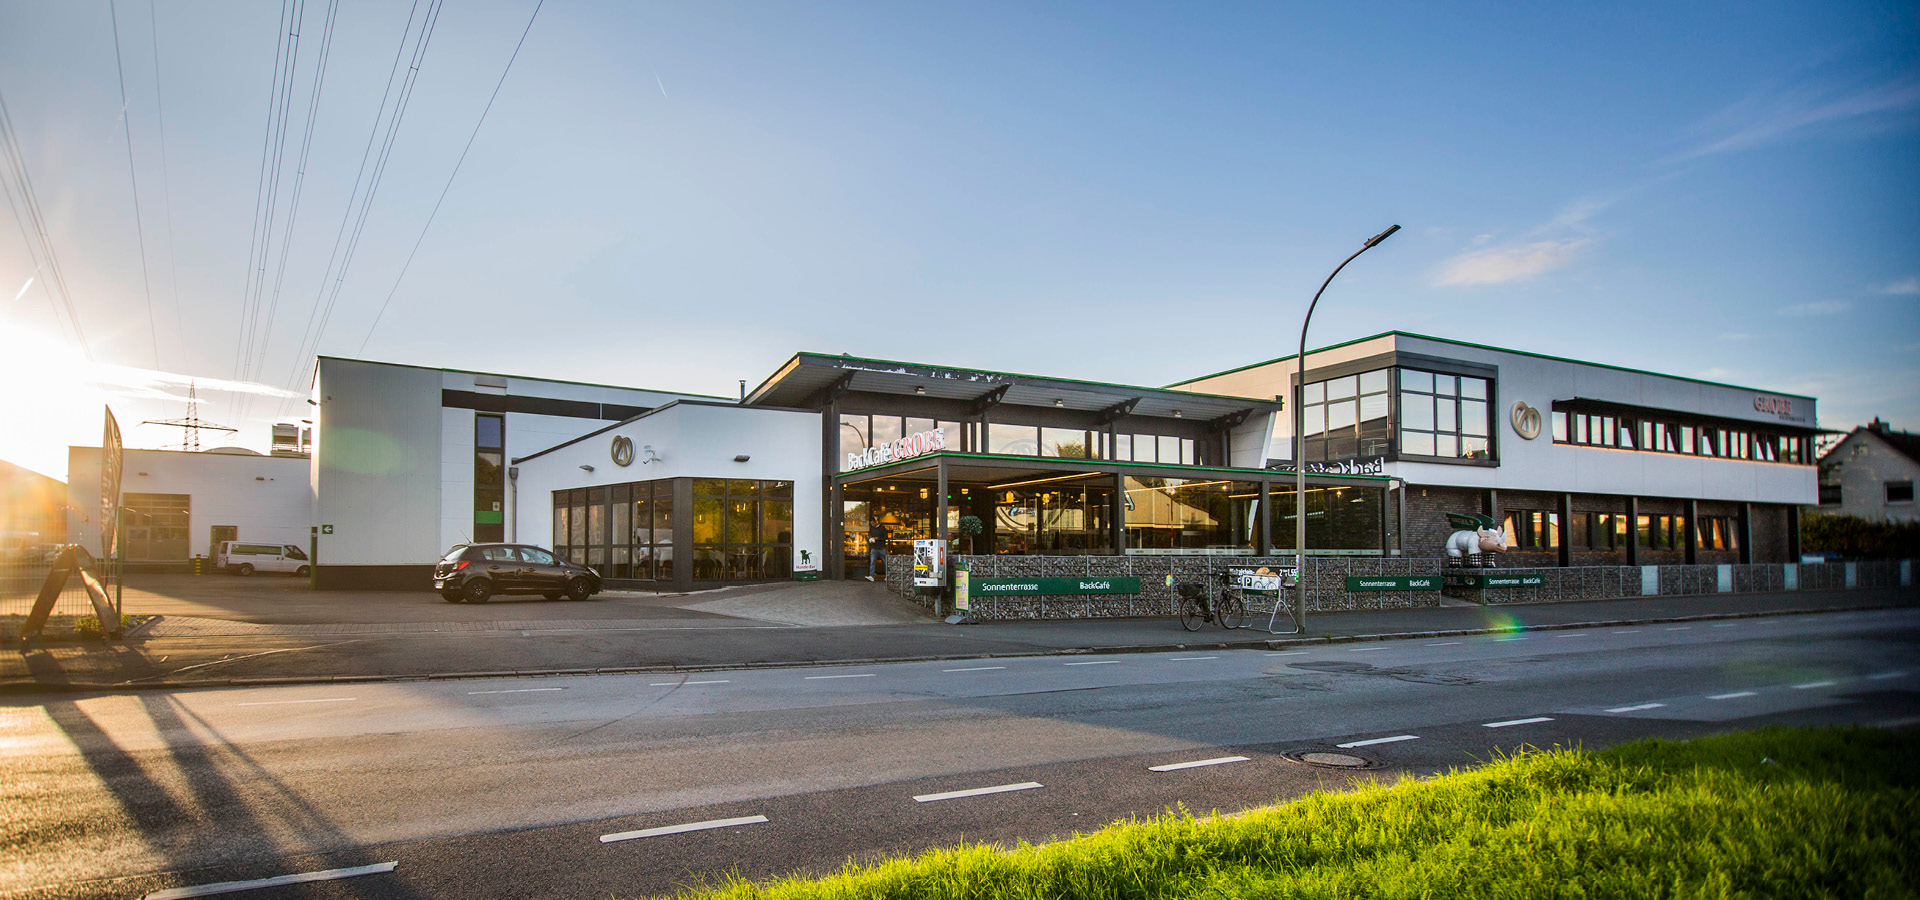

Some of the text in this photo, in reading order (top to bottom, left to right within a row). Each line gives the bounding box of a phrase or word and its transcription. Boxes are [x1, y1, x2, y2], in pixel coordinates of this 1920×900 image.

[1754, 396, 1792, 415] GROBE
[892, 428, 945, 460] GROBE
[982, 581, 1110, 591] Sonnenterrasse BackCafé
[1409, 579, 1430, 587] BackCafé
